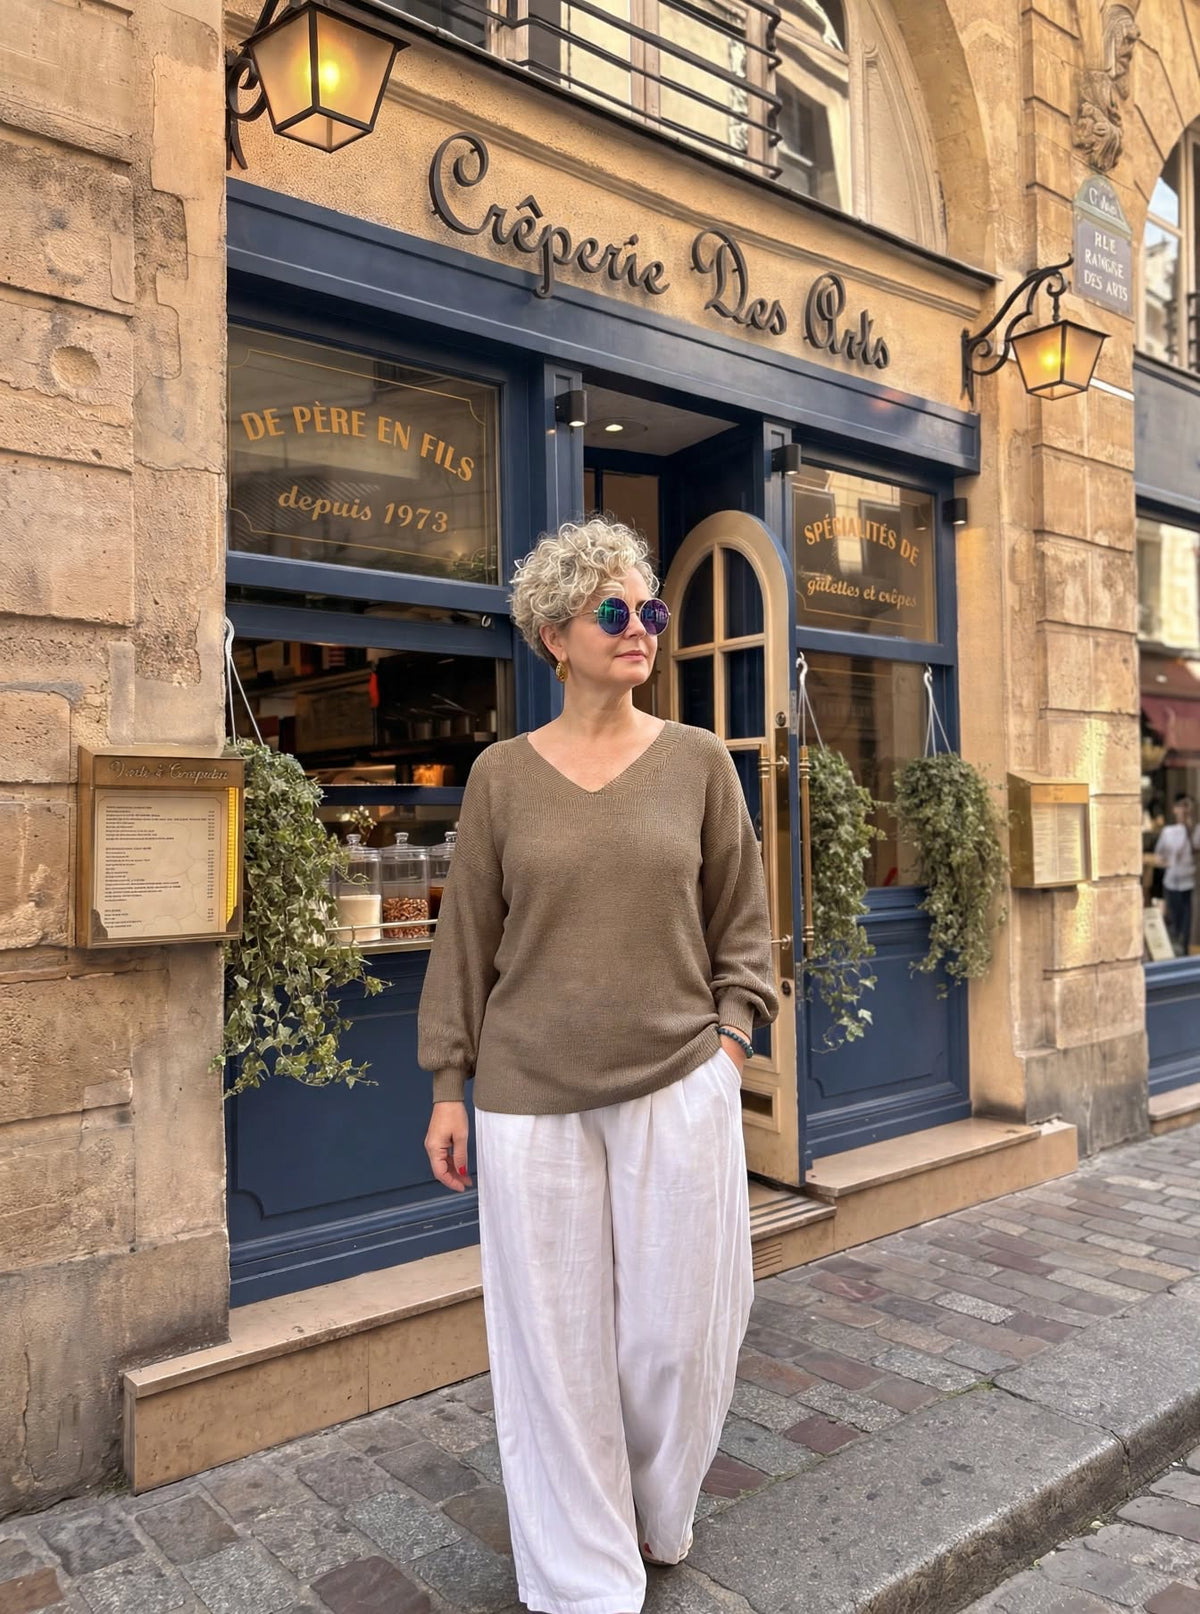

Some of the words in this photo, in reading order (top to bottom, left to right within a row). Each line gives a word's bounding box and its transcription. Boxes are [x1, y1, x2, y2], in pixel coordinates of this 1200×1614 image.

[428, 131, 671, 299] Crêperie
[690, 226, 788, 336] Des
[803, 271, 892, 370] Arts
[1083, 269, 1103, 291] DES
[240, 407, 285, 441] DE
[292, 400, 368, 438] PÈRE
[377, 415, 412, 450] EN
[419, 432, 475, 483] FILS
[277, 485, 373, 521] depuis
[383, 502, 449, 533] 1973
[804, 513, 897, 550] SPÉCIALITÉS
[900, 538, 920, 567] DE
[863, 585, 876, 601] et
[878, 588, 918, 611] crêpes
